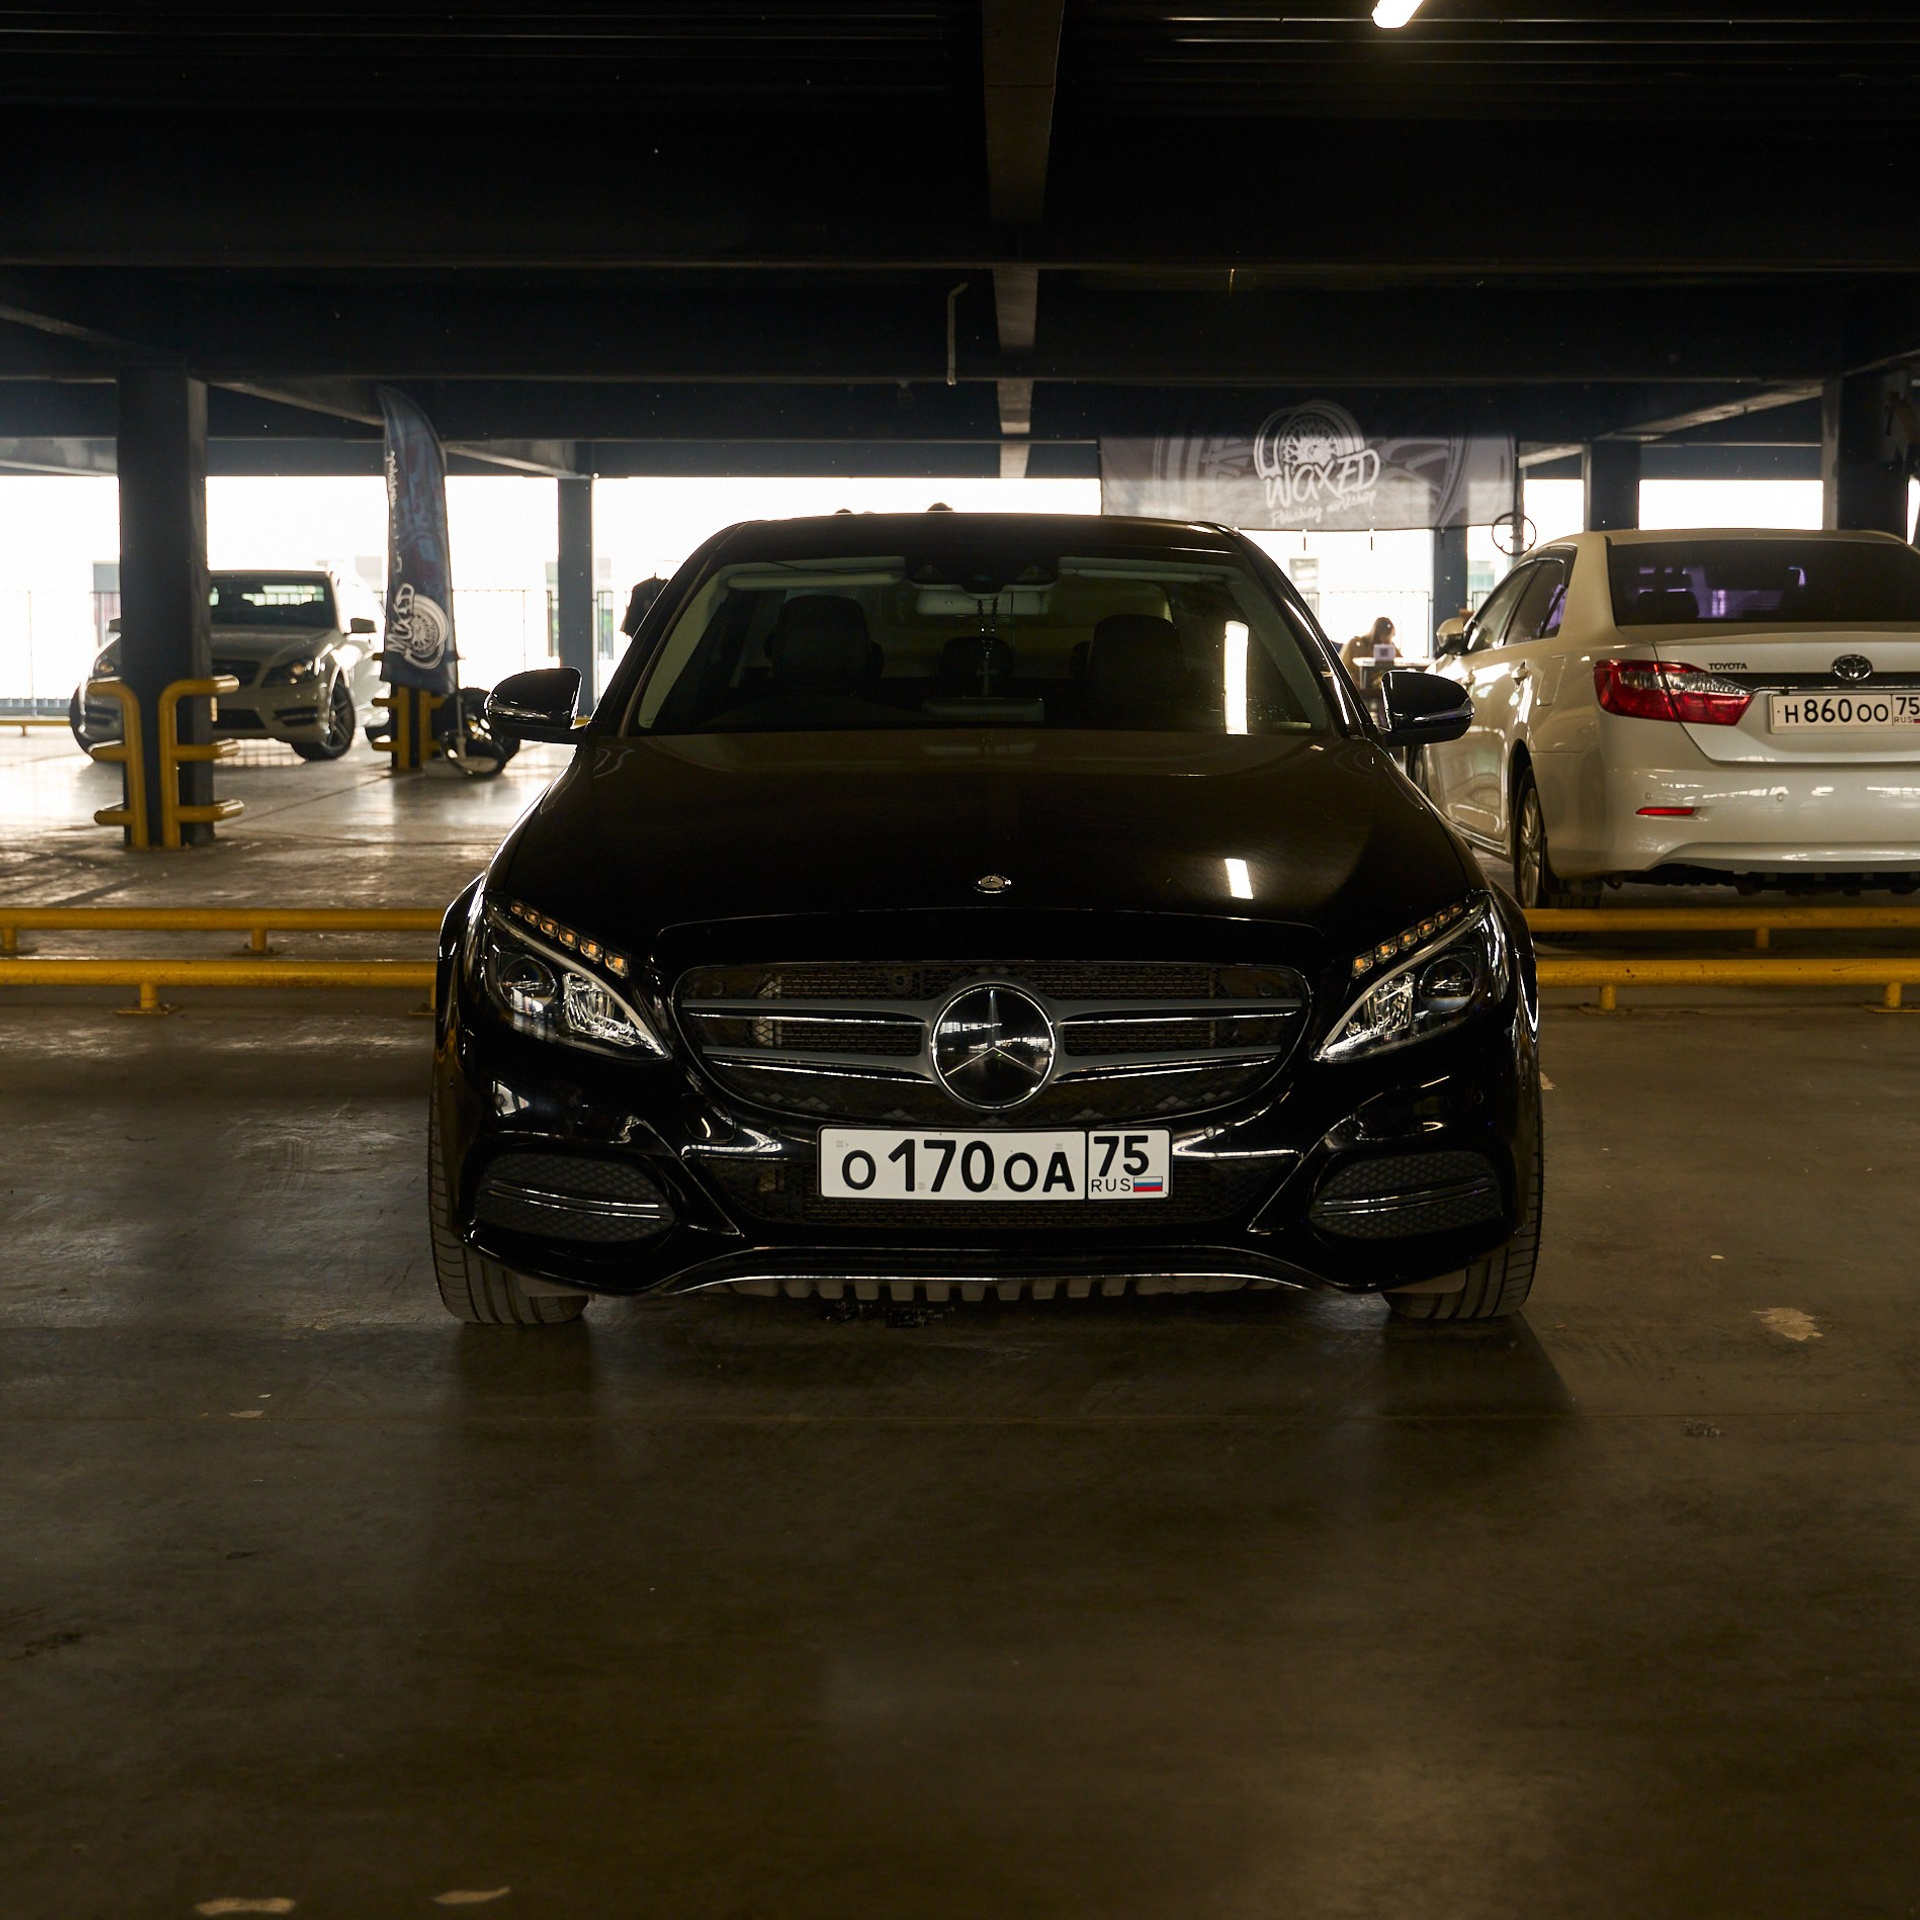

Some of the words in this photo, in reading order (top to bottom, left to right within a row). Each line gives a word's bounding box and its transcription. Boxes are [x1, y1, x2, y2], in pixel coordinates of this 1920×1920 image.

[1708, 662, 1747, 670] TOYOTA
[1896, 697, 1920, 716] 75
[1093, 1136, 1149, 1176] 75
[1091, 1178, 1131, 1192] RUS
